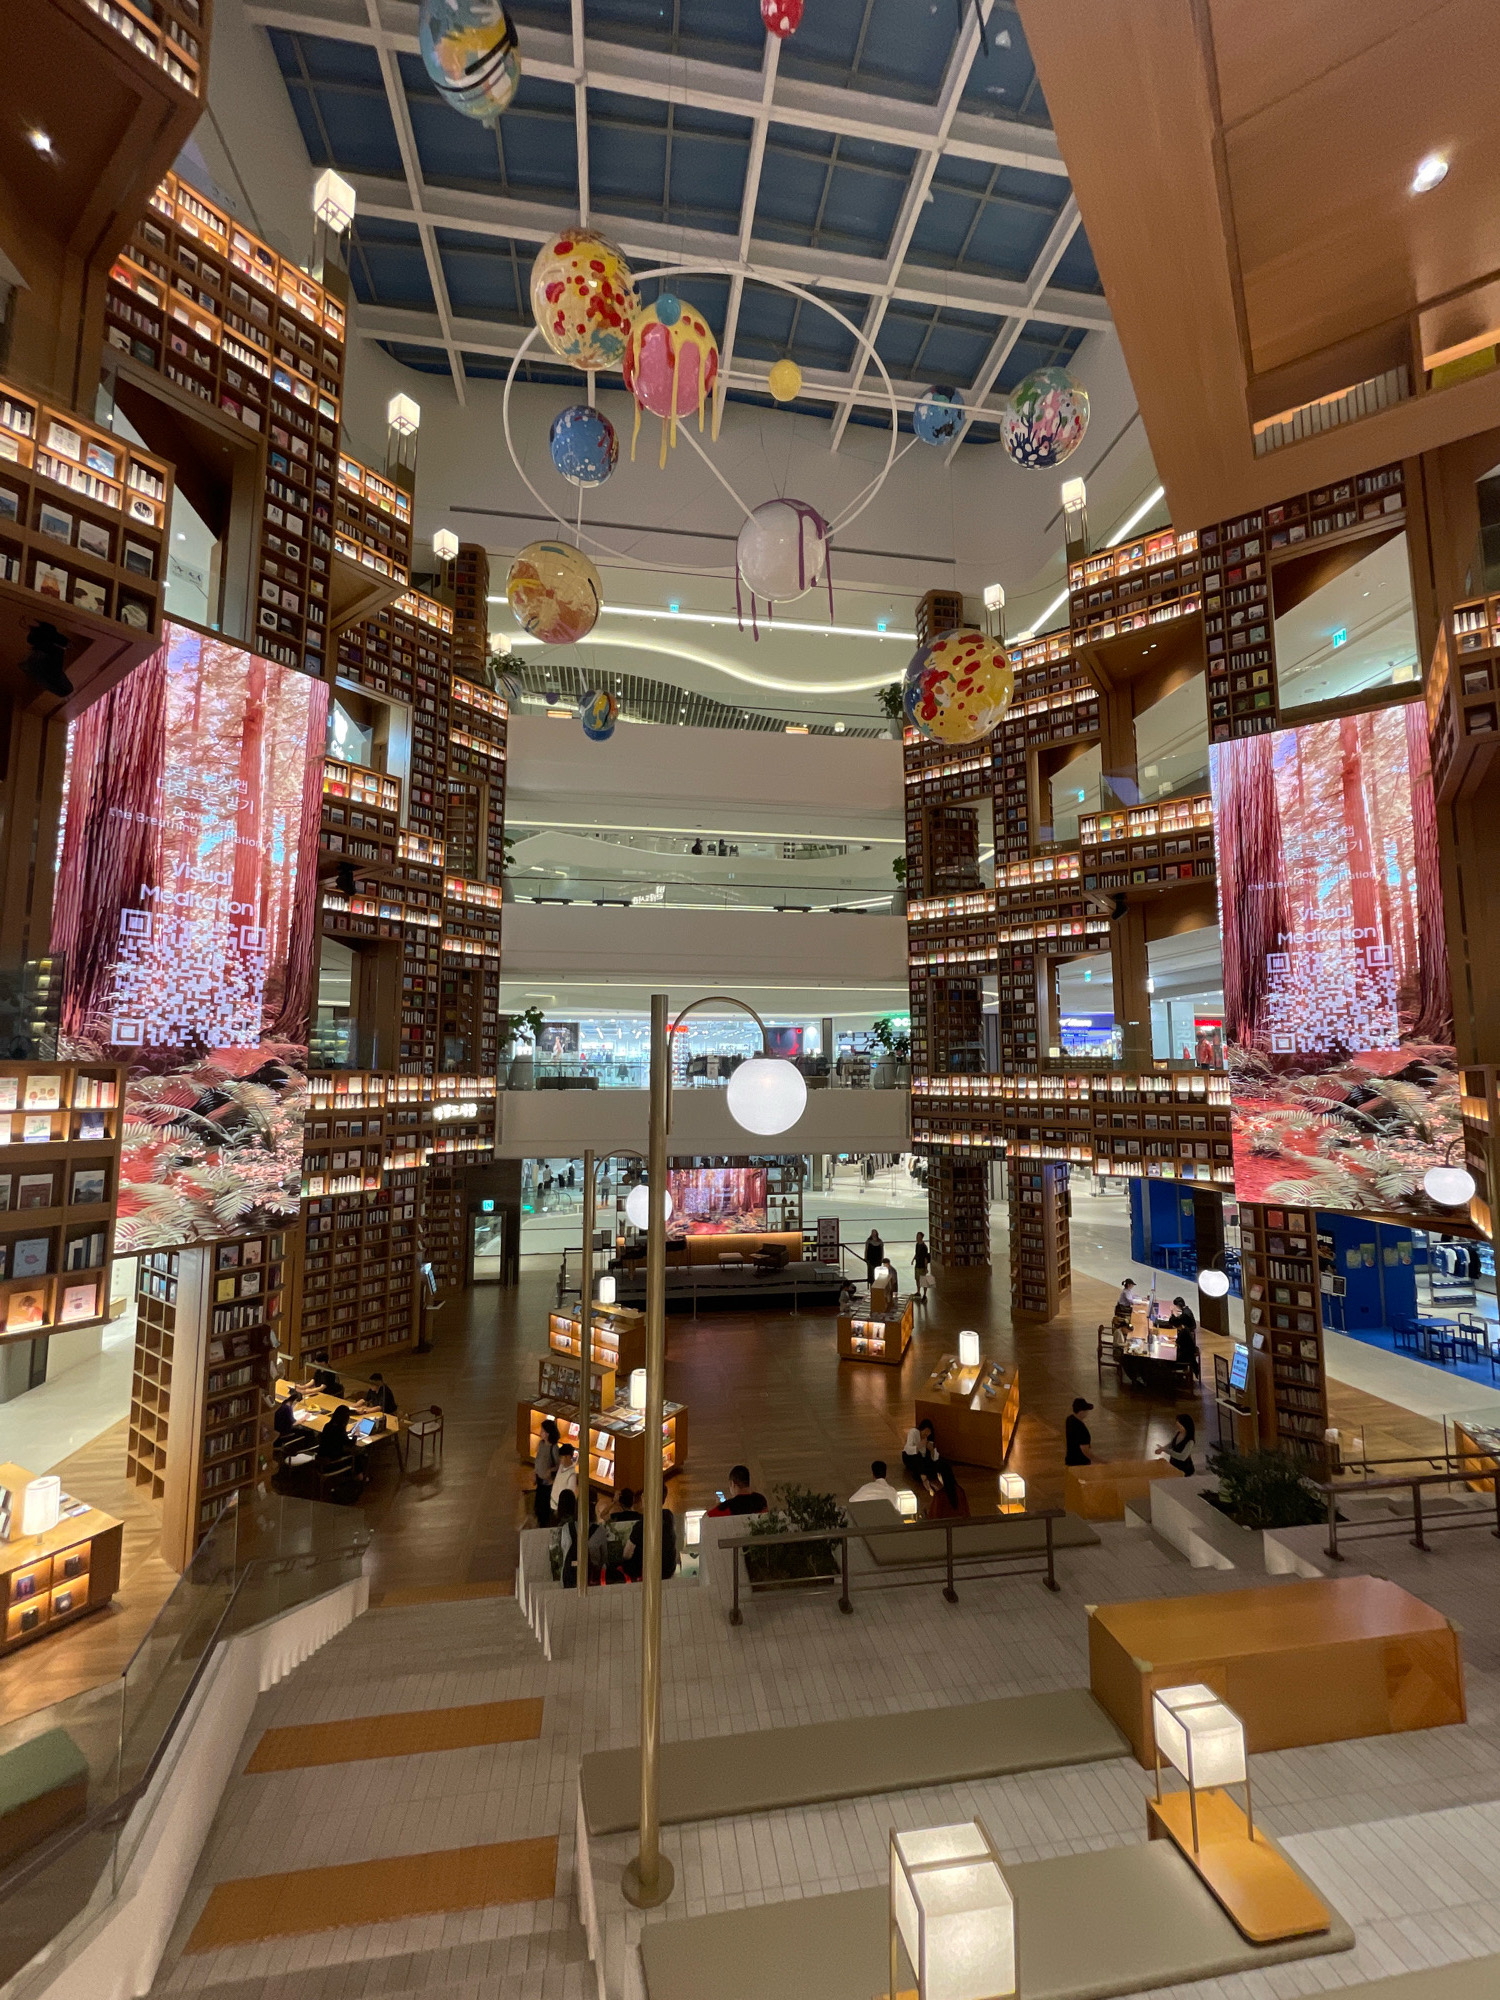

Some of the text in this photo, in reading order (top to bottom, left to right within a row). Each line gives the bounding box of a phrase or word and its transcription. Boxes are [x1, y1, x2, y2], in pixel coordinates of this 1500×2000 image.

[225, 794, 254, 815] 받기
[136, 812, 198, 836] Breathing
[173, 806, 234, 828] Dowoad
[1336, 838, 1362, 854] 받기
[172, 858, 233, 885] Visual
[1294, 862, 1346, 875] Dowoad
[1267, 878, 1317, 890] Breathing
[1321, 870, 1377, 885] itation
[141, 884, 254, 916] Meditation
[1297, 905, 1352, 921] Visual
[1278, 926, 1377, 945] Meditation
